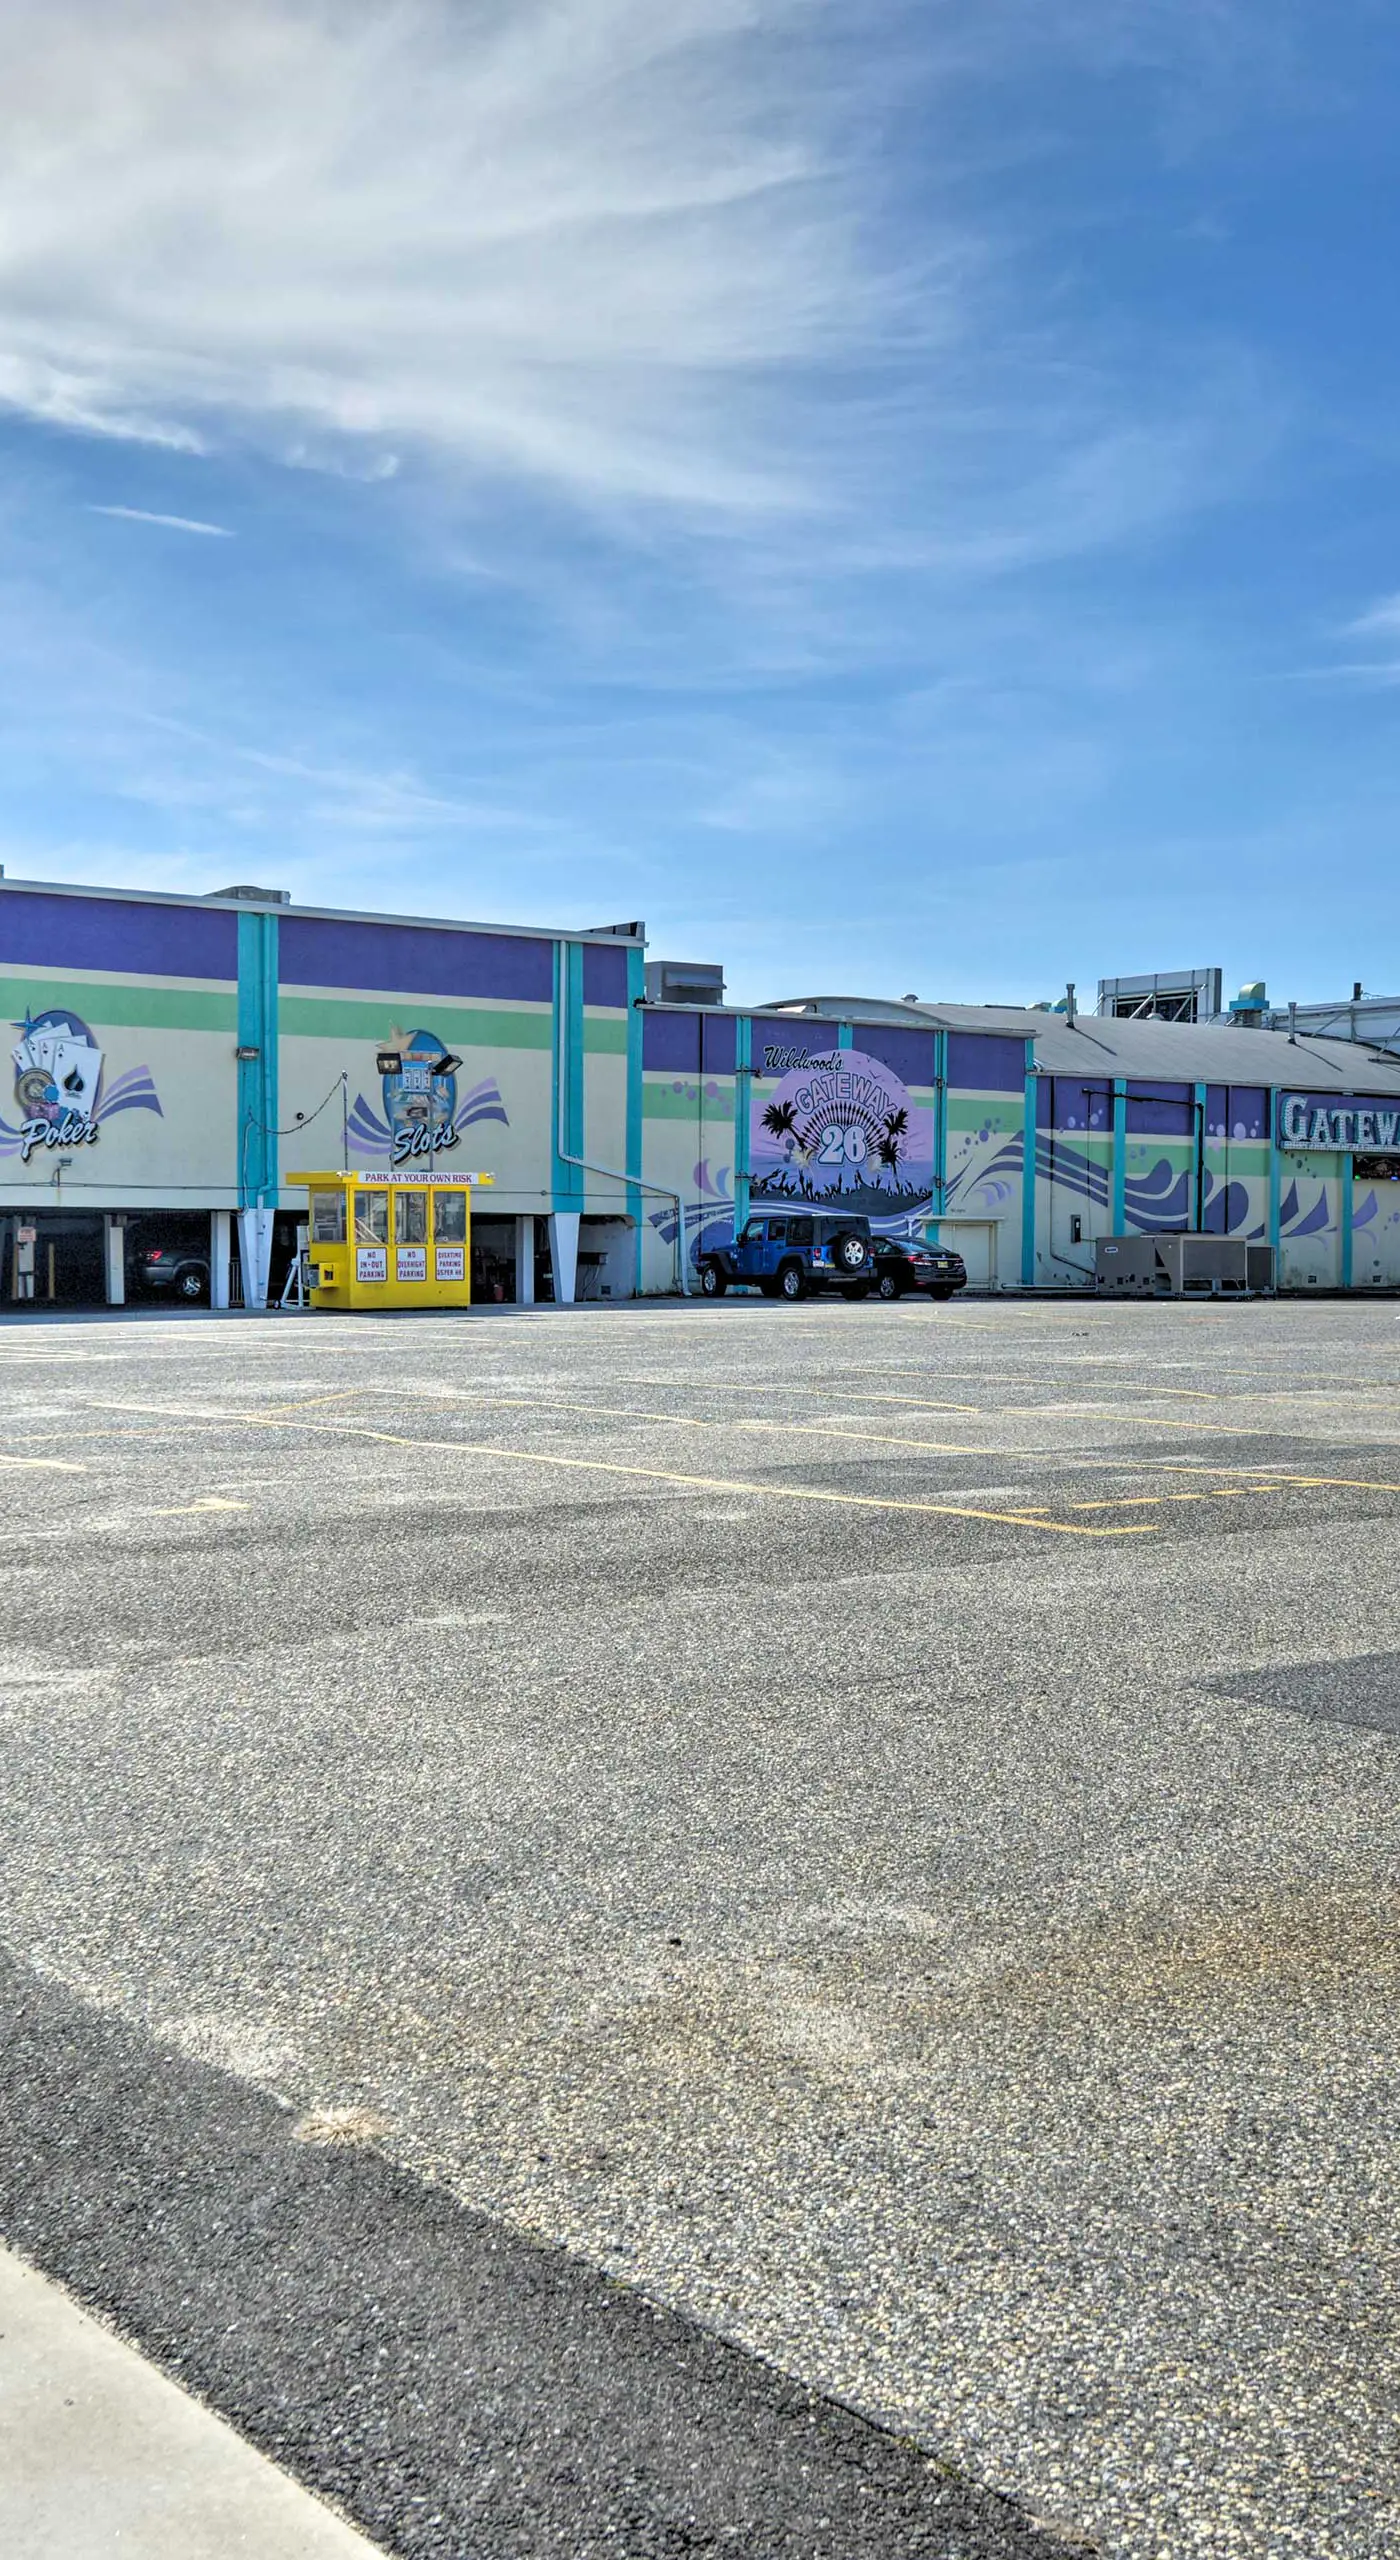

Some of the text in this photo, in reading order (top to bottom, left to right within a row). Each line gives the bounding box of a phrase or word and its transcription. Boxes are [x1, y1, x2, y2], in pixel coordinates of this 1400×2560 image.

[764, 1045, 843, 1071] Wildwood's
[795, 1072, 898, 1121] GATEWAY
[21, 1111, 98, 1162] Poker
[1282, 1095, 1400, 1145] GATEW
[391, 1122, 459, 1165] Slots
[818, 1124, 867, 1164] 26
[365, 1173, 472, 1183] PARK AT YOUR OWN RISK
[359, 1270, 385, 1278] PARKING
[399, 1270, 424, 1278] PARKING
